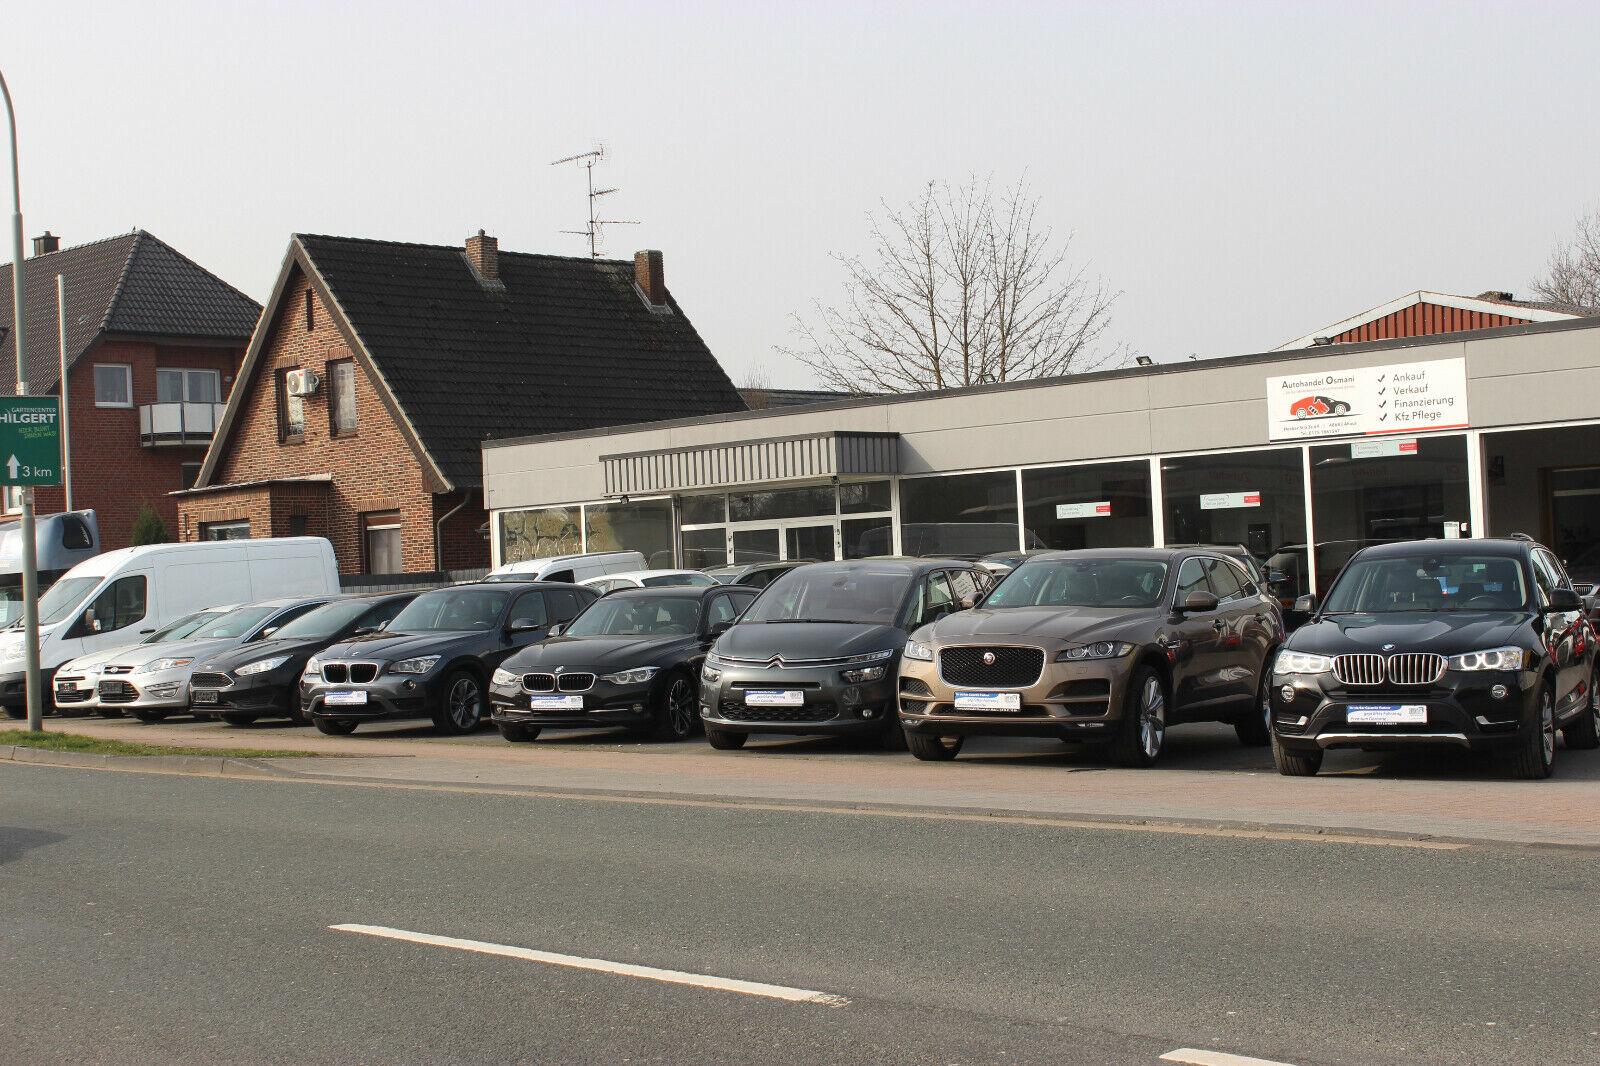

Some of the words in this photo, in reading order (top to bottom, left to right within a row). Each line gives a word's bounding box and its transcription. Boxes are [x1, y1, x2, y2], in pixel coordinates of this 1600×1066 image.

[1393, 370, 1425, 382] Ankauf
[1281, 379, 1324, 389] Autohandel
[1326, 376, 1355, 385] Osmani
[1393, 384, 1428, 395] Verkauf
[1394, 397, 1454, 408] Finanzierung
[1395, 412, 1409, 421] Kfz
[1412, 410, 1442, 421] Pflege
[22, 465, 31, 477] 3
[34, 466, 52, 477] km
